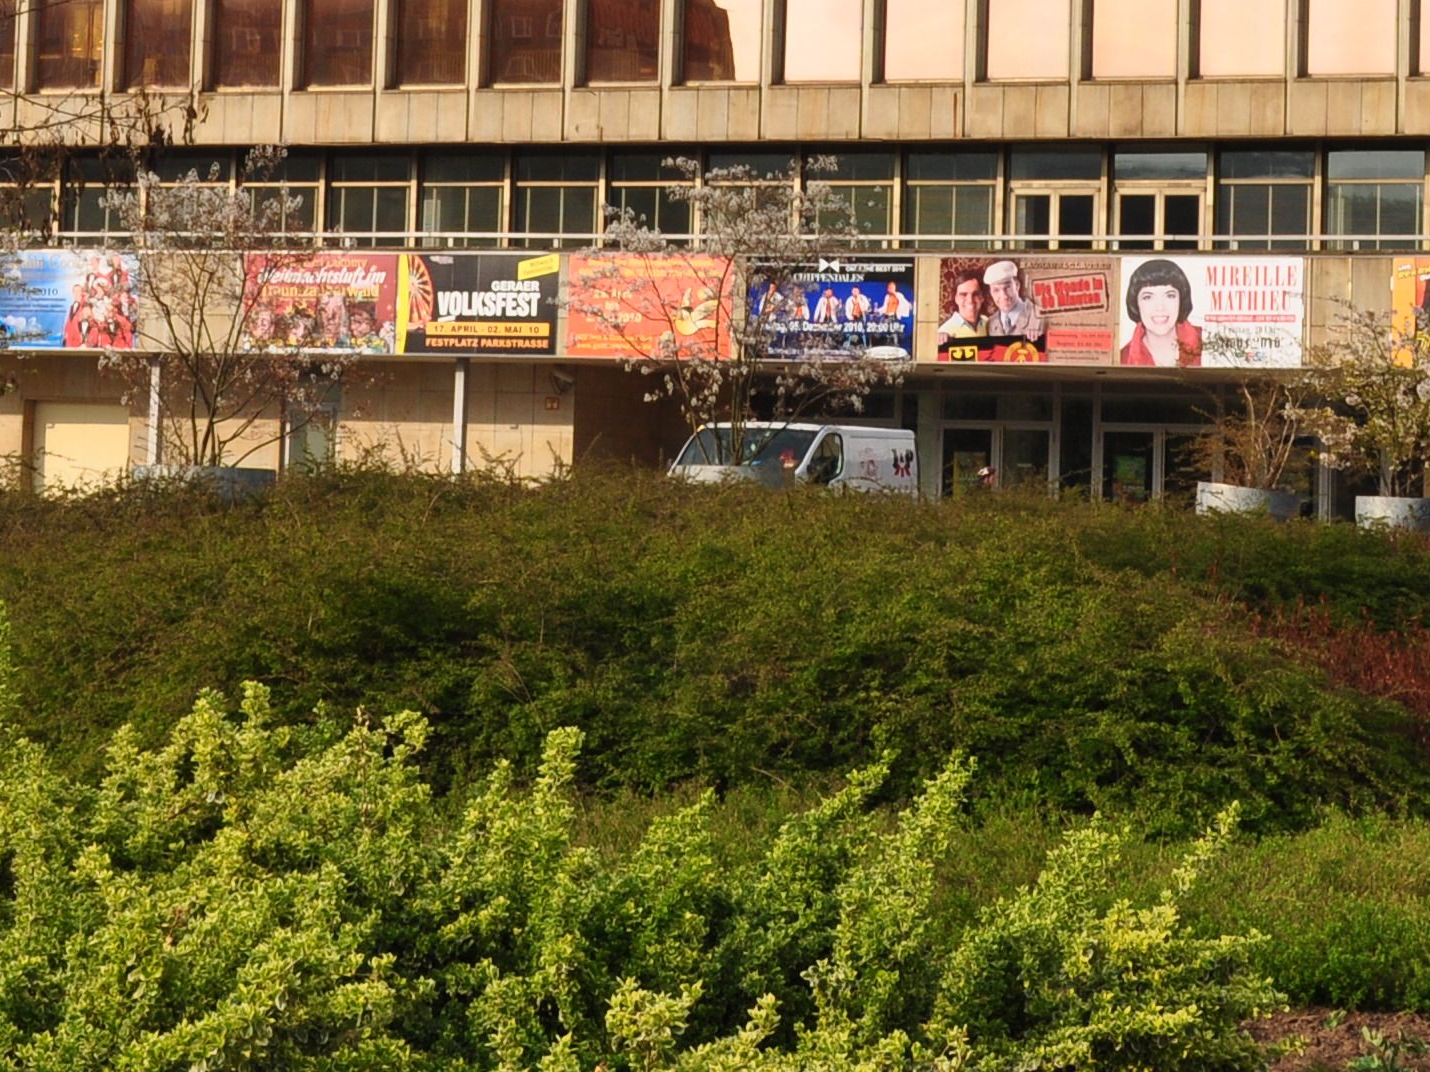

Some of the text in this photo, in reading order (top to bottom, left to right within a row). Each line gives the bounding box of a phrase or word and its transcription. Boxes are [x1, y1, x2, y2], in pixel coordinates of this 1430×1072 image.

[1205, 265, 1297, 287] MIREILLE
[491, 280, 541, 292] GERAER
[437, 291, 541, 317] VOLKSFEST
[1211, 291, 1292, 311] MATHIEU
[450, 325, 479, 334] APRIL
[487, 325, 502, 334] 02.
[504, 325, 522, 334] MAI
[426, 338, 549, 349] FESTPLATZ PARKSTRASSE
